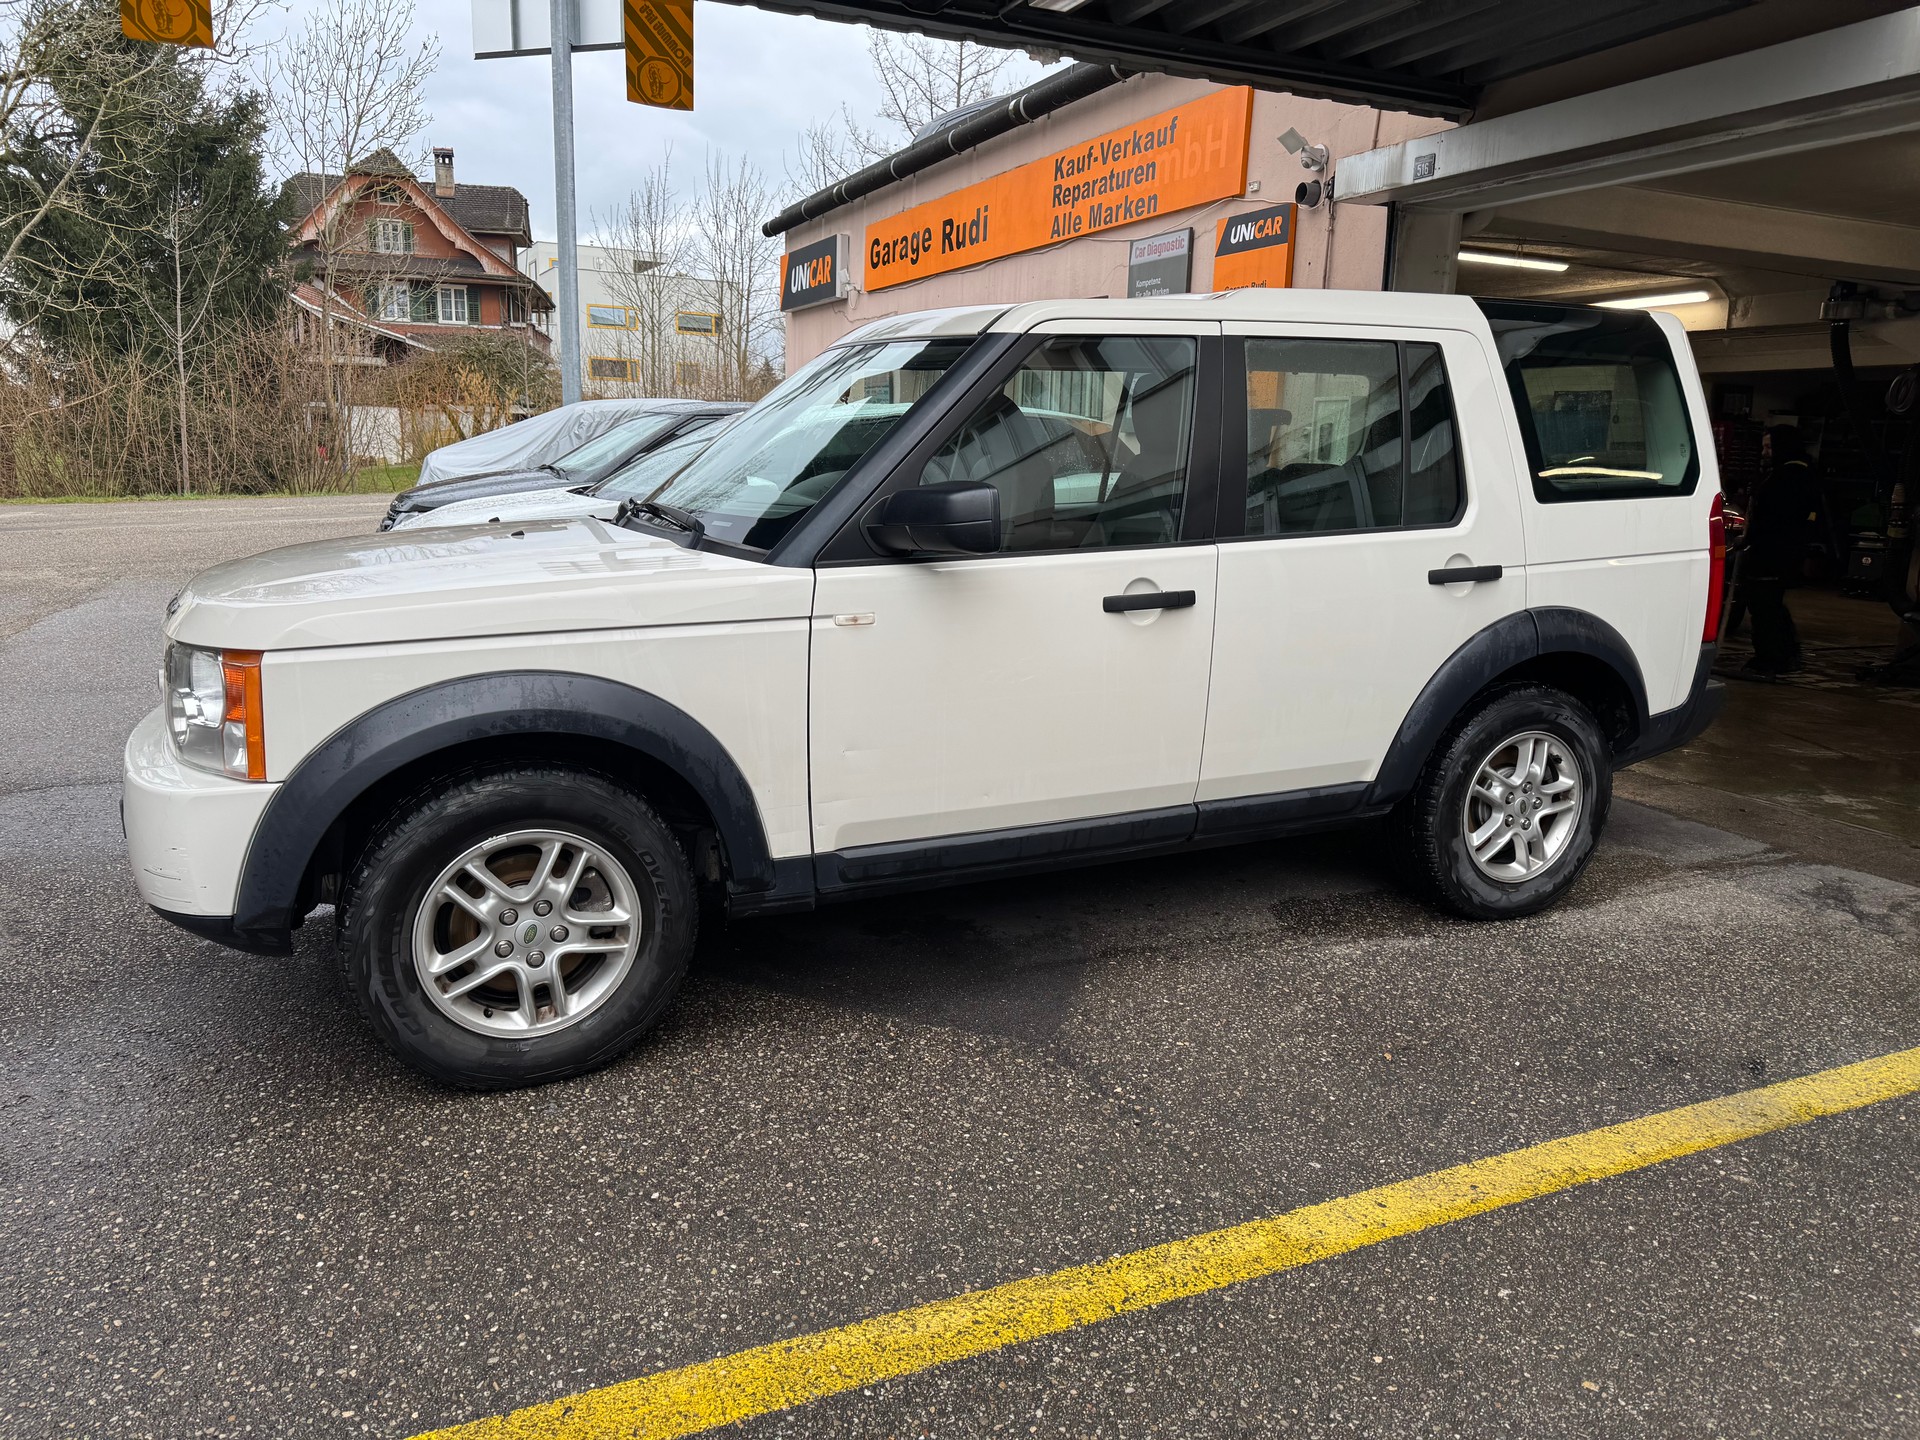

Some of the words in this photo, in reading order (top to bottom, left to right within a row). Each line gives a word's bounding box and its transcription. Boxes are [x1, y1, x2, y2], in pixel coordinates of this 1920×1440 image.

[1053, 116, 1178, 182] Kauf-Verkauf
[1417, 162, 1429, 176] 516
[1052, 161, 1156, 209] Reparaturen
[870, 226, 932, 270] Garage
[941, 204, 989, 254] Rudi
[1050, 212, 1082, 239] Alle
[1088, 193, 1158, 229] Marken
[1134, 245, 1146, 259] Car
[1147, 235, 1185, 257] Diagnostic
[1135, 277, 1161, 288] Kompetenz
